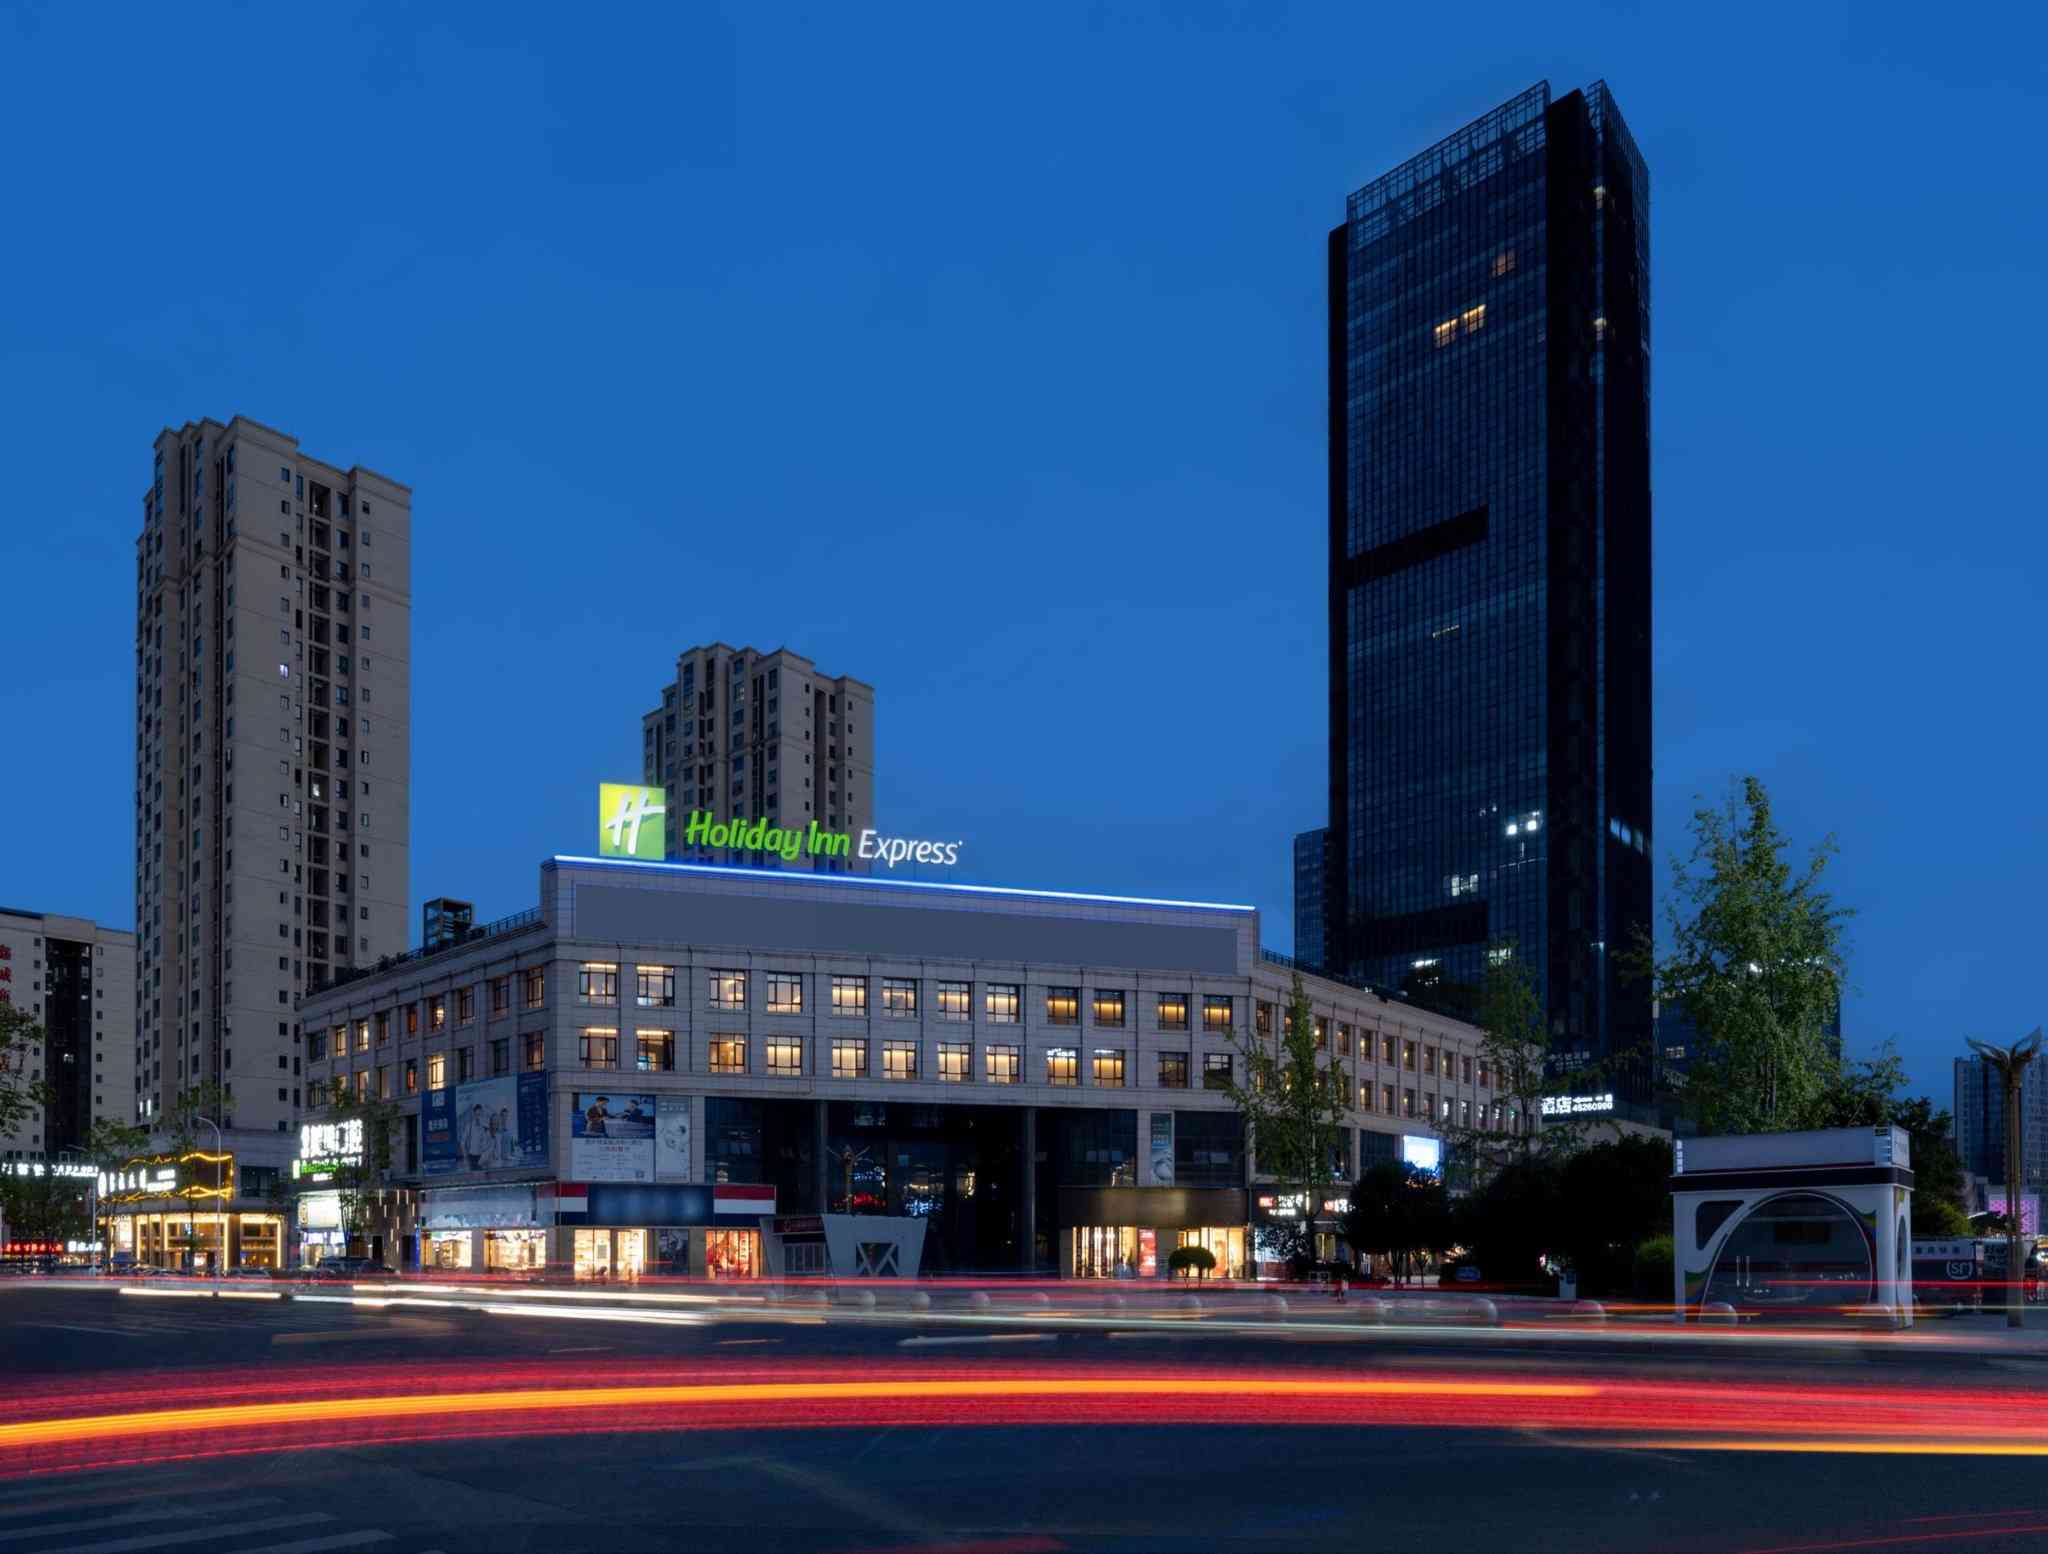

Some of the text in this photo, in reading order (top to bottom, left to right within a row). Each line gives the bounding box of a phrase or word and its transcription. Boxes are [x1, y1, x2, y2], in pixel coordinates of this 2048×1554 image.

[686, 810, 960, 868] Holiday Inn Express
[1541, 1096, 1572, 1114] 酒店
